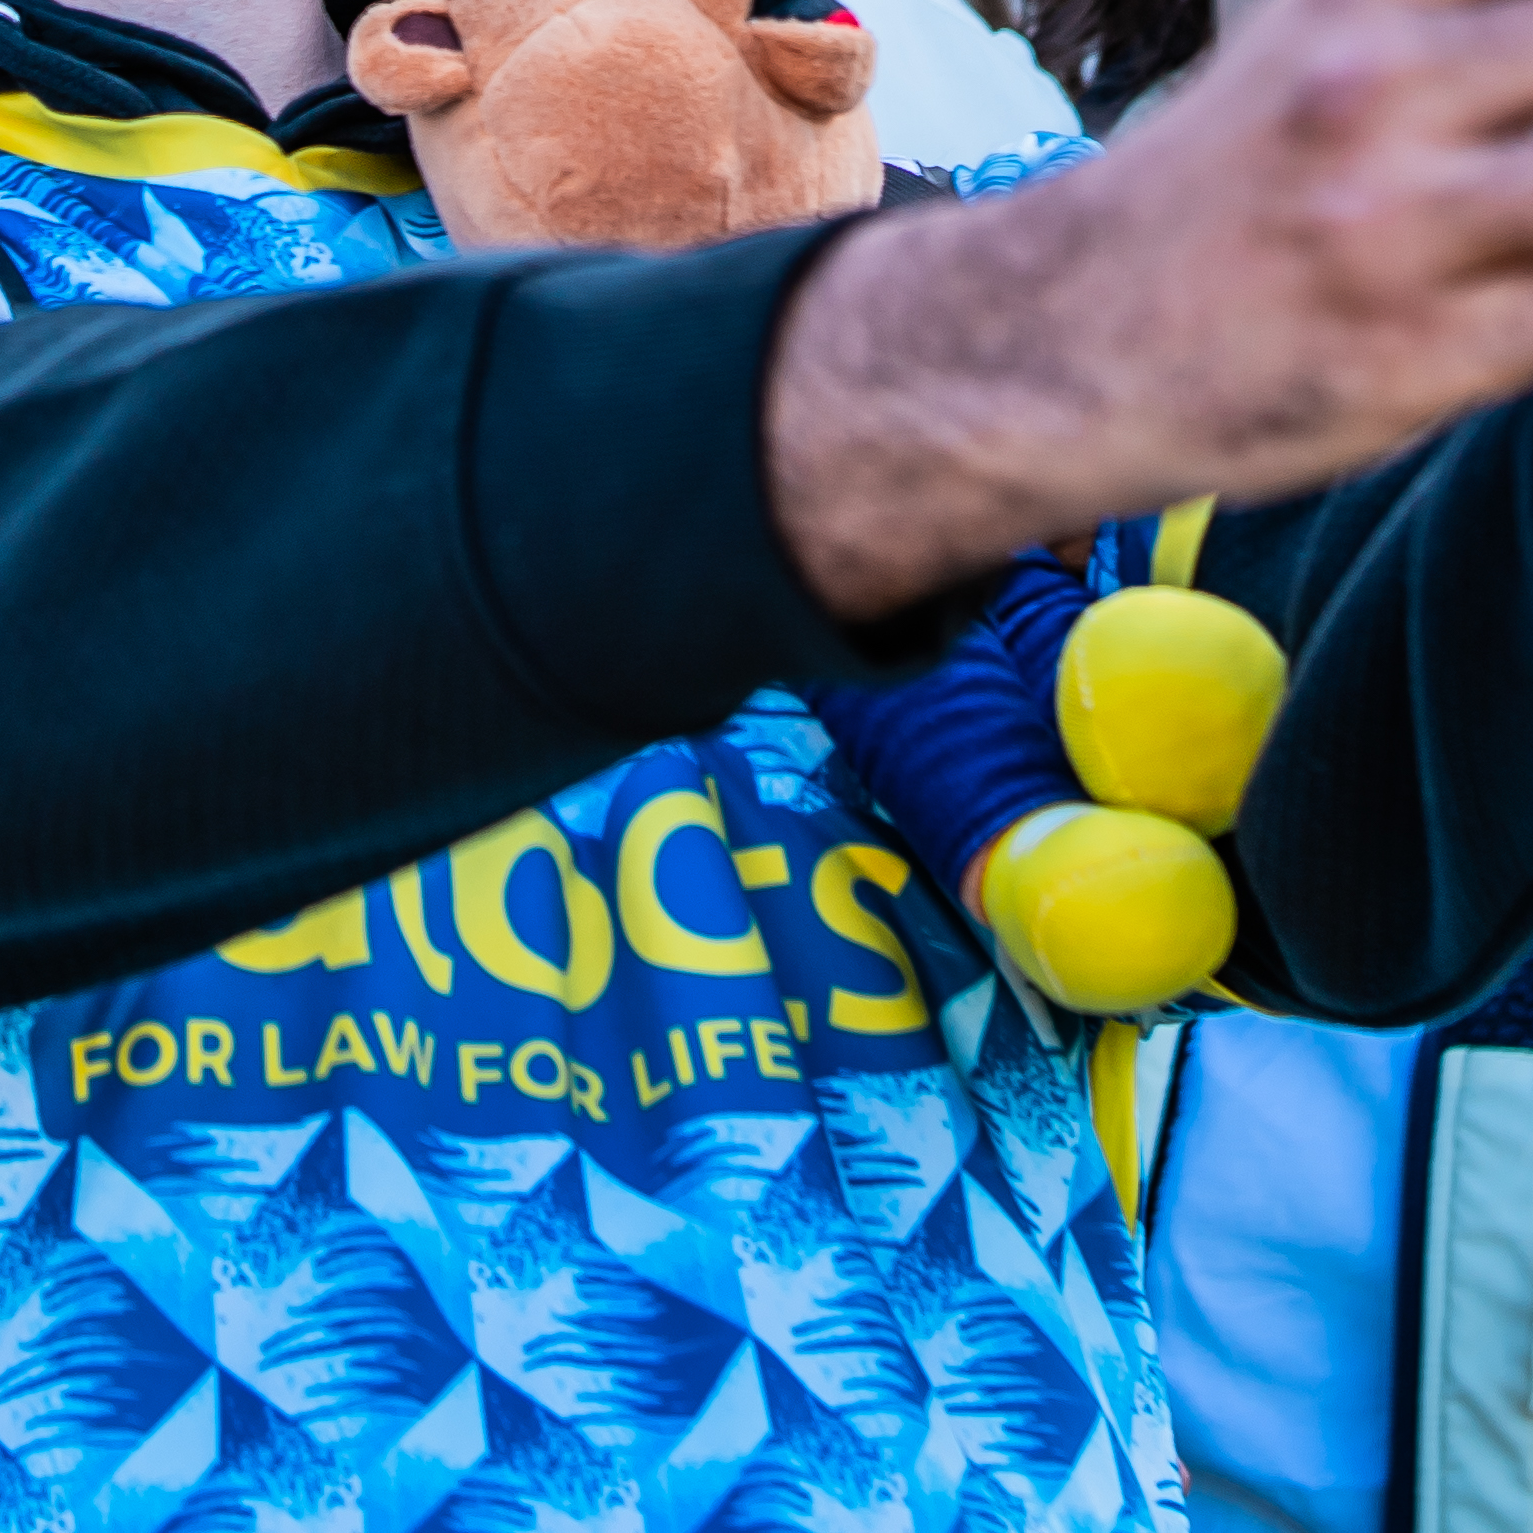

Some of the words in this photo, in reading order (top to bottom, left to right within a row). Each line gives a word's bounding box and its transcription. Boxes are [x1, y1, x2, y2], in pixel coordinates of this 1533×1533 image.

[71, 1019, 234, 1102] FOR
[262, 1011, 435, 1089] LAW
[458, 1035, 609, 1123] FOR
